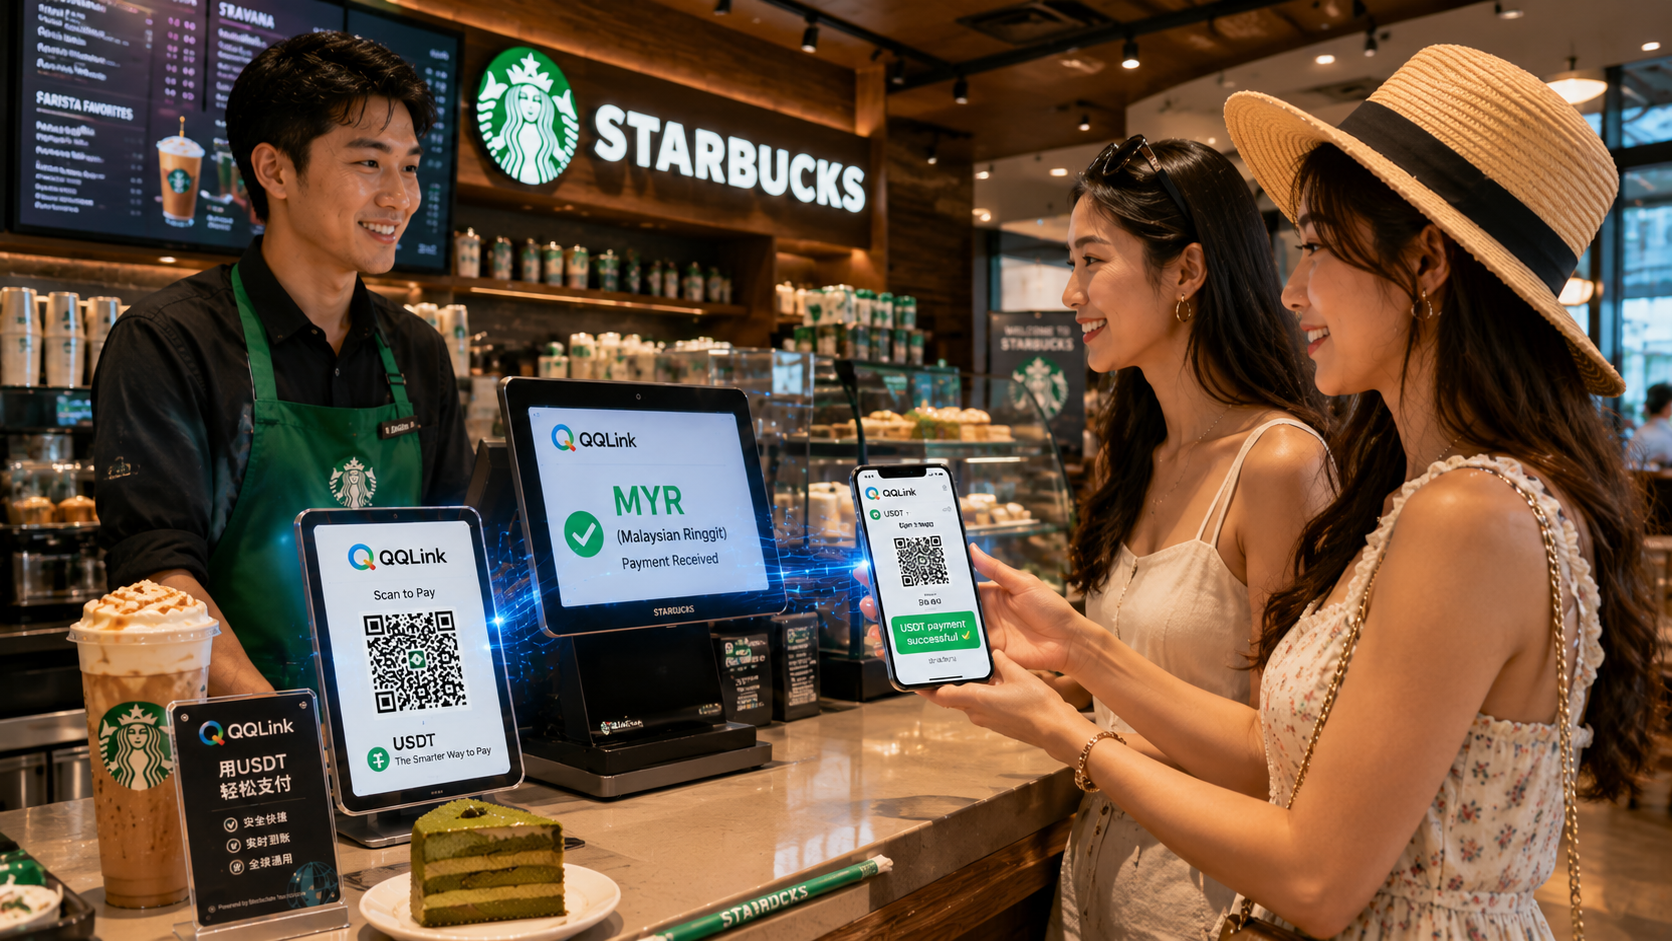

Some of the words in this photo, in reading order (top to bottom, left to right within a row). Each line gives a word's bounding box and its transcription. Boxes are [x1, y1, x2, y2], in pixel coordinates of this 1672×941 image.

[593, 103, 867, 214] STARBUCKS
[1004, 325, 1054, 337] WELCOME
[1001, 337, 1074, 352] STARBUCKS
[579, 431, 637, 448] QQLink
[612, 485, 685, 516] MYR
[882, 487, 917, 498] QQLink
[617, 529, 681, 546] (Malaysian
[683, 526, 728, 543] Ringgit)
[379, 547, 448, 567] QQLink
[622, 555, 671, 572] Payment
[672, 552, 719, 567] Received
[373, 589, 401, 601] Scan
[402, 588, 415, 600] to
[416, 587, 436, 602] Pay
[927, 620, 966, 632] payment
[227, 718, 295, 740] QQLink
[392, 733, 436, 751] USDT
[219, 753, 287, 778] 用USDT
[395, 757, 411, 766] The
[413, 753, 445, 764] Smarter
[447, 750, 465, 760] Way
[466, 749, 475, 757] to
[476, 746, 492, 756] Pay
[220, 774, 292, 800] 轻松支付
